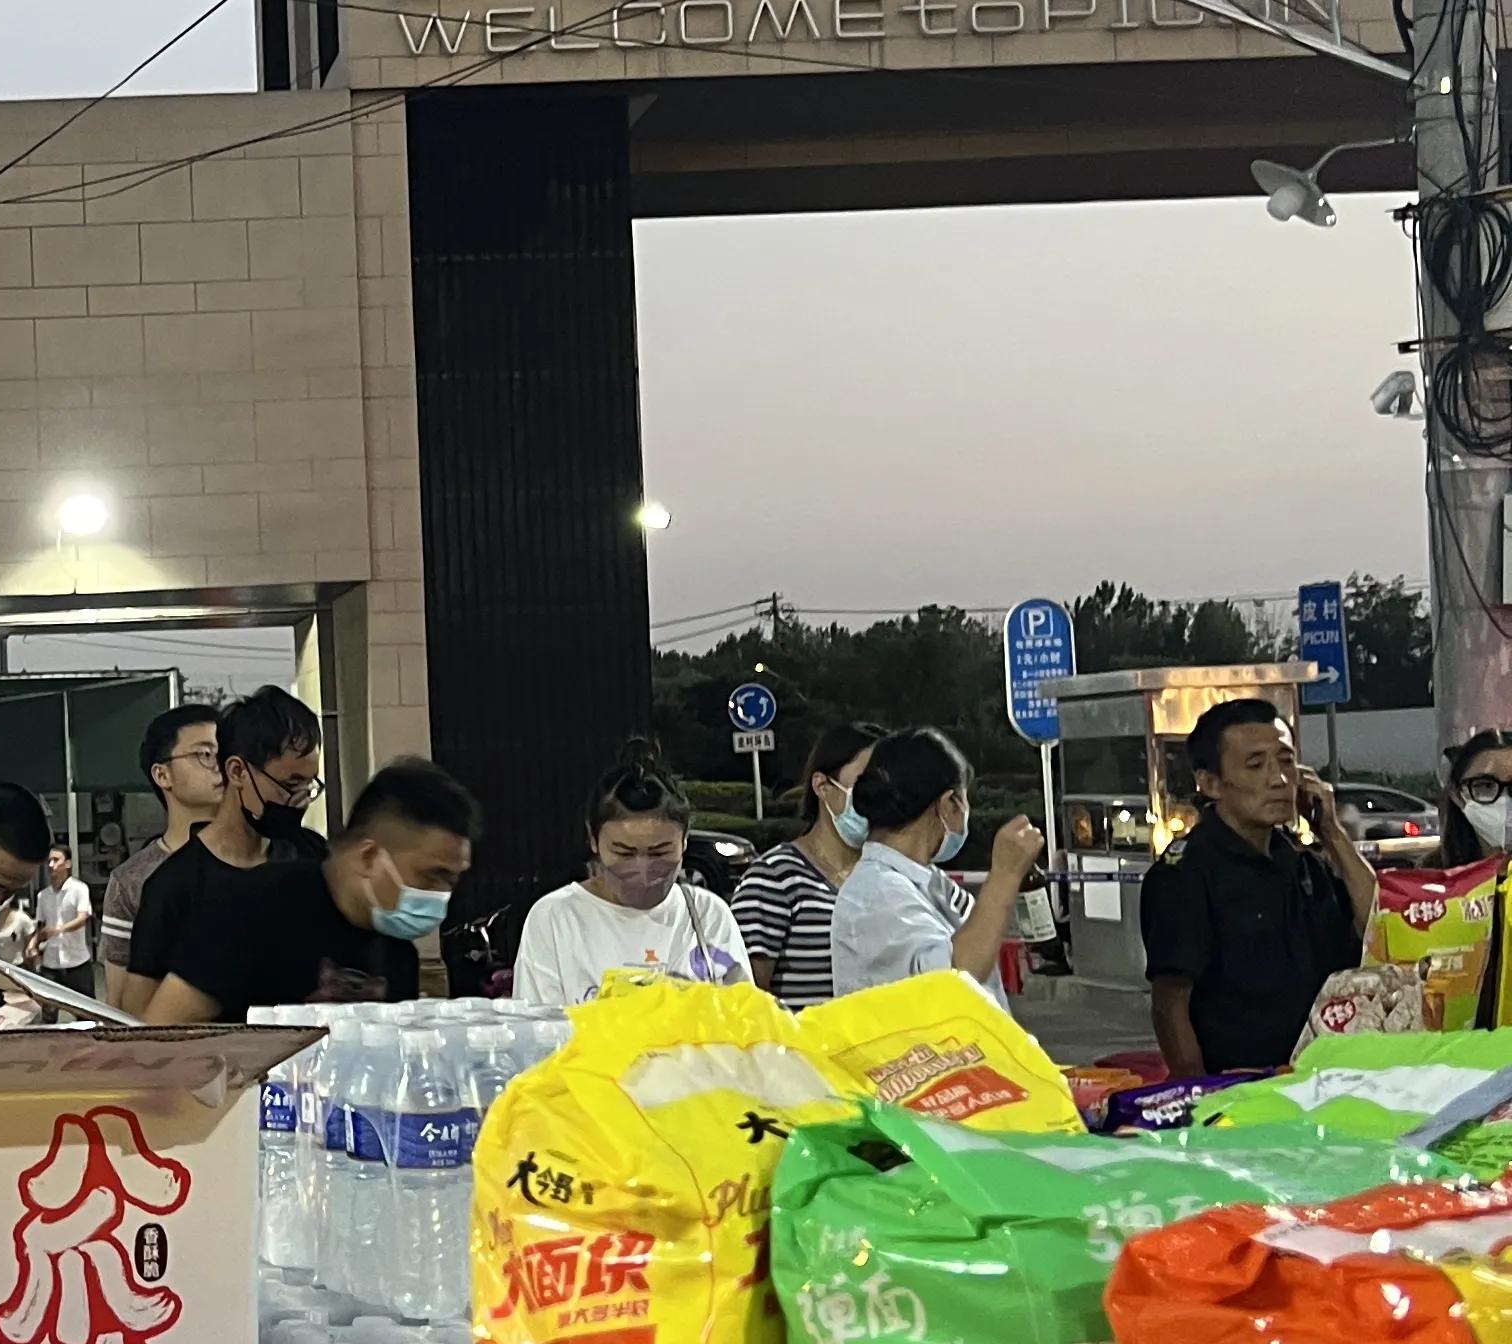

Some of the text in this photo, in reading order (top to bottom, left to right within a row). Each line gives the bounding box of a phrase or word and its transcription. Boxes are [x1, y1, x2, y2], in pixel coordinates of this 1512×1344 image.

[1302, 599, 1338, 621] 皮村
[1302, 630, 1340, 645] PICUN
[708, 1172, 772, 1227] Plu
